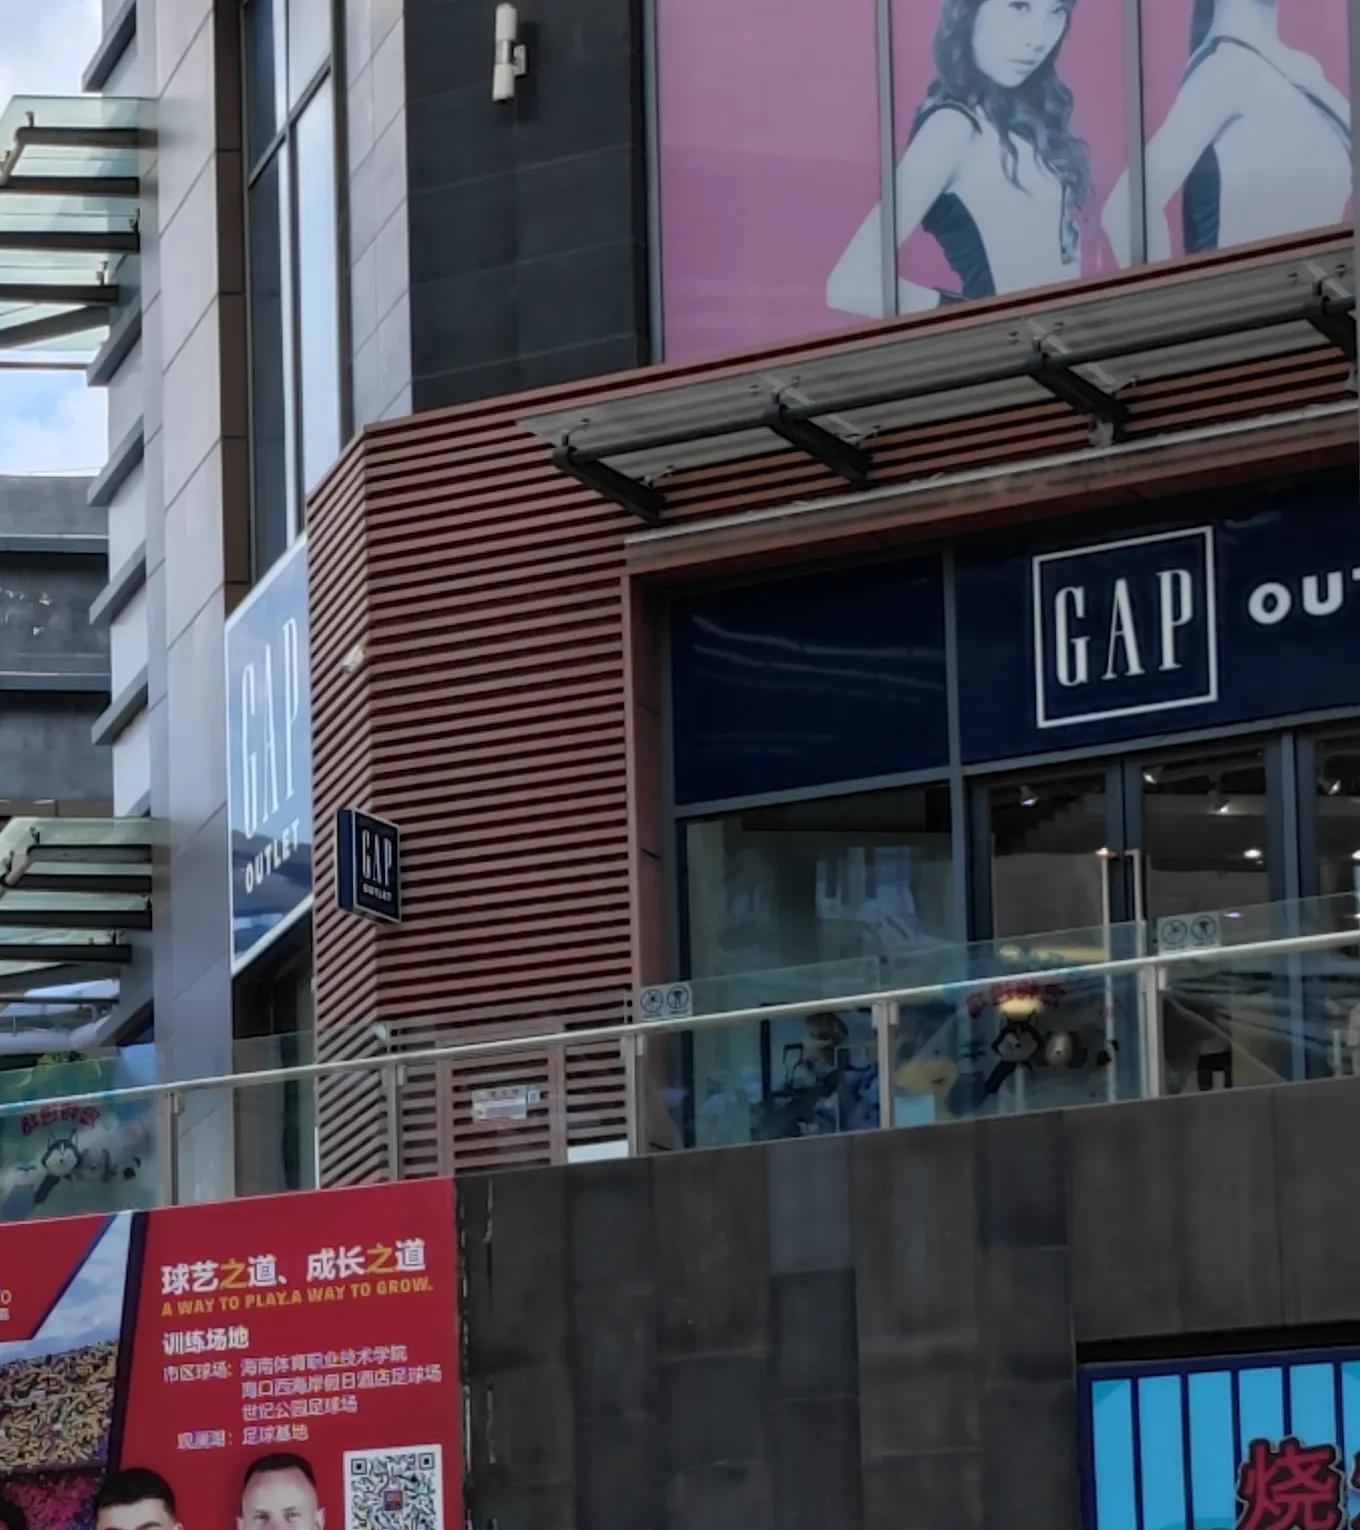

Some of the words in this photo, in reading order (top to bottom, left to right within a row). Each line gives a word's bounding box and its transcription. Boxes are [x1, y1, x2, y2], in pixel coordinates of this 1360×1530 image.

[1054, 568, 1194, 688] GAP
[1248, 567, 1360, 625] OU
[240, 617, 299, 840] GAP
[244, 818, 299, 895] OUTLET
[361, 828, 394, 888] GAP
[162, 1326, 249, 1356] 训练场地
